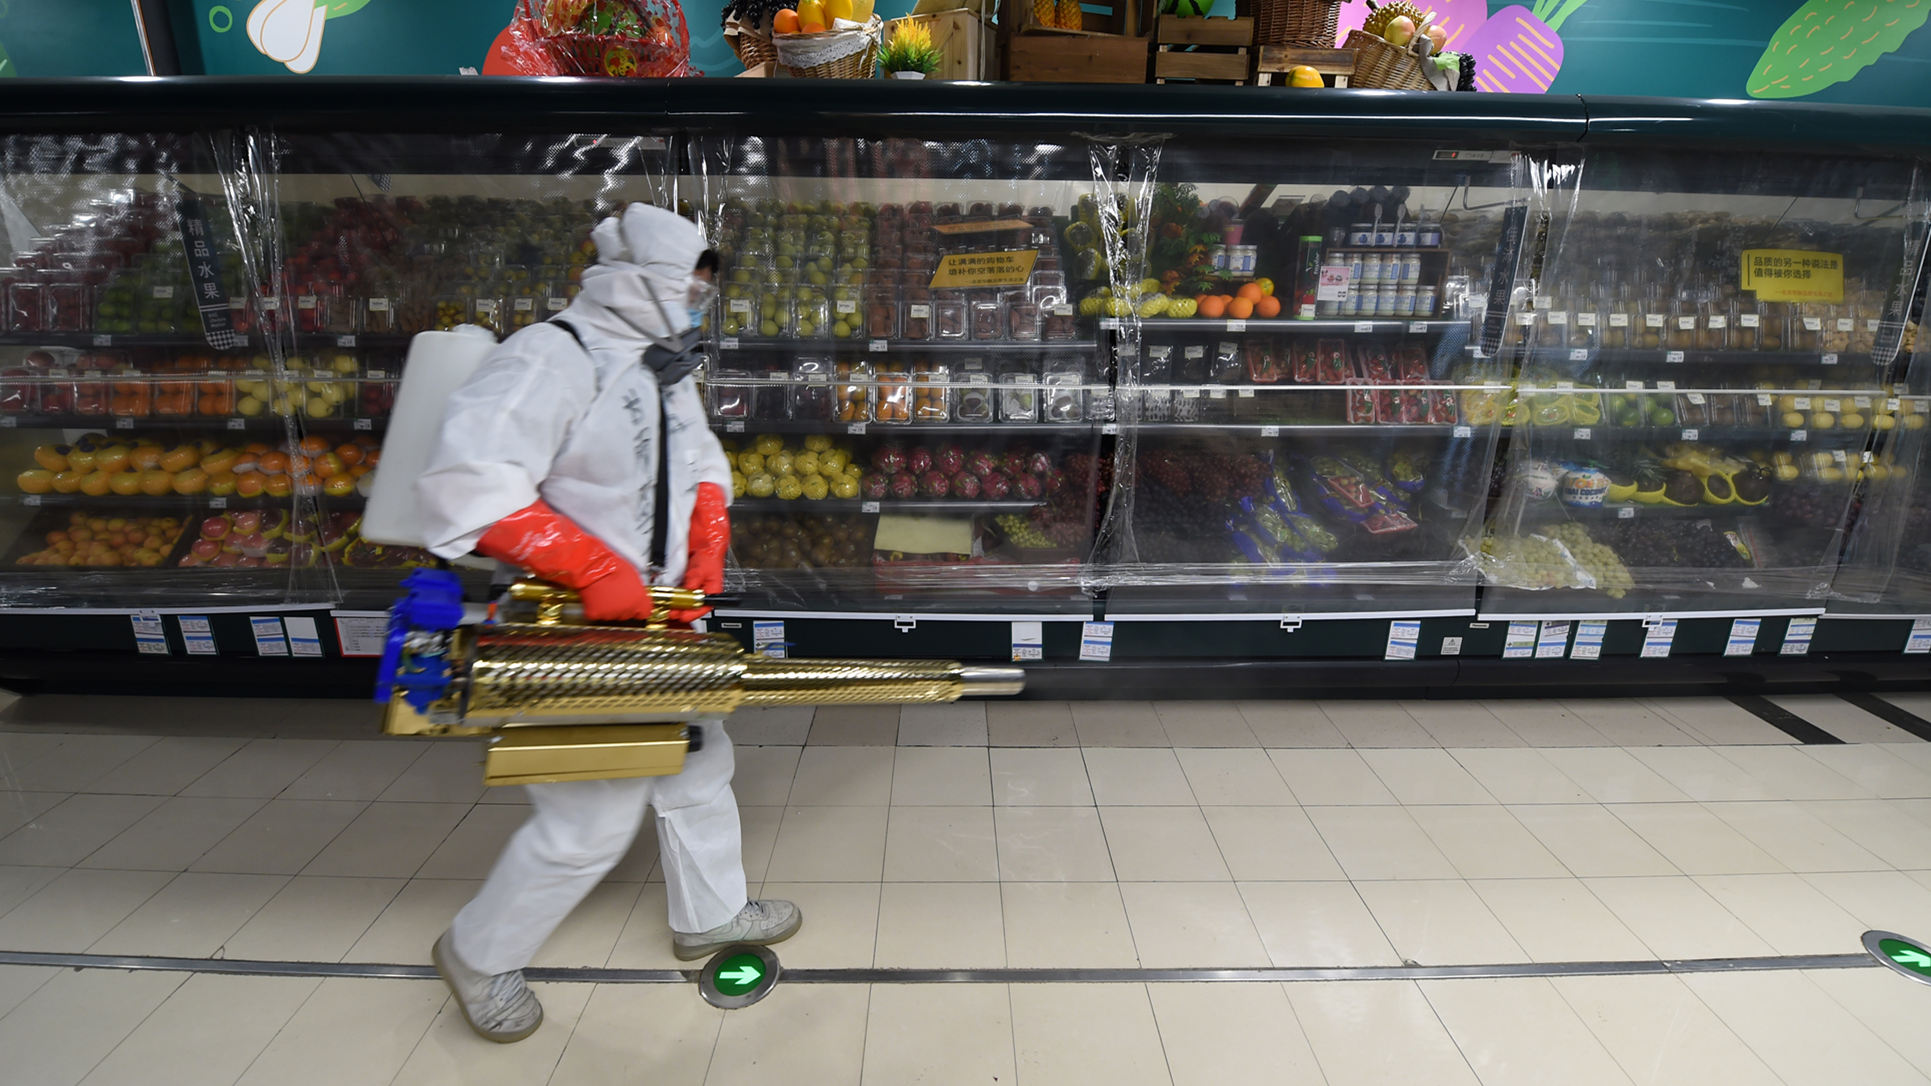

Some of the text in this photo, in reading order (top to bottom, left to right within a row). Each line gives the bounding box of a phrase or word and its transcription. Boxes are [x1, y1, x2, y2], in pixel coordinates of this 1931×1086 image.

[188, 219, 219, 298] 精品水果
[1753, 256, 1838, 270] 品质的另一种说法是
[1753, 268, 1812, 279] 值得被你选择
